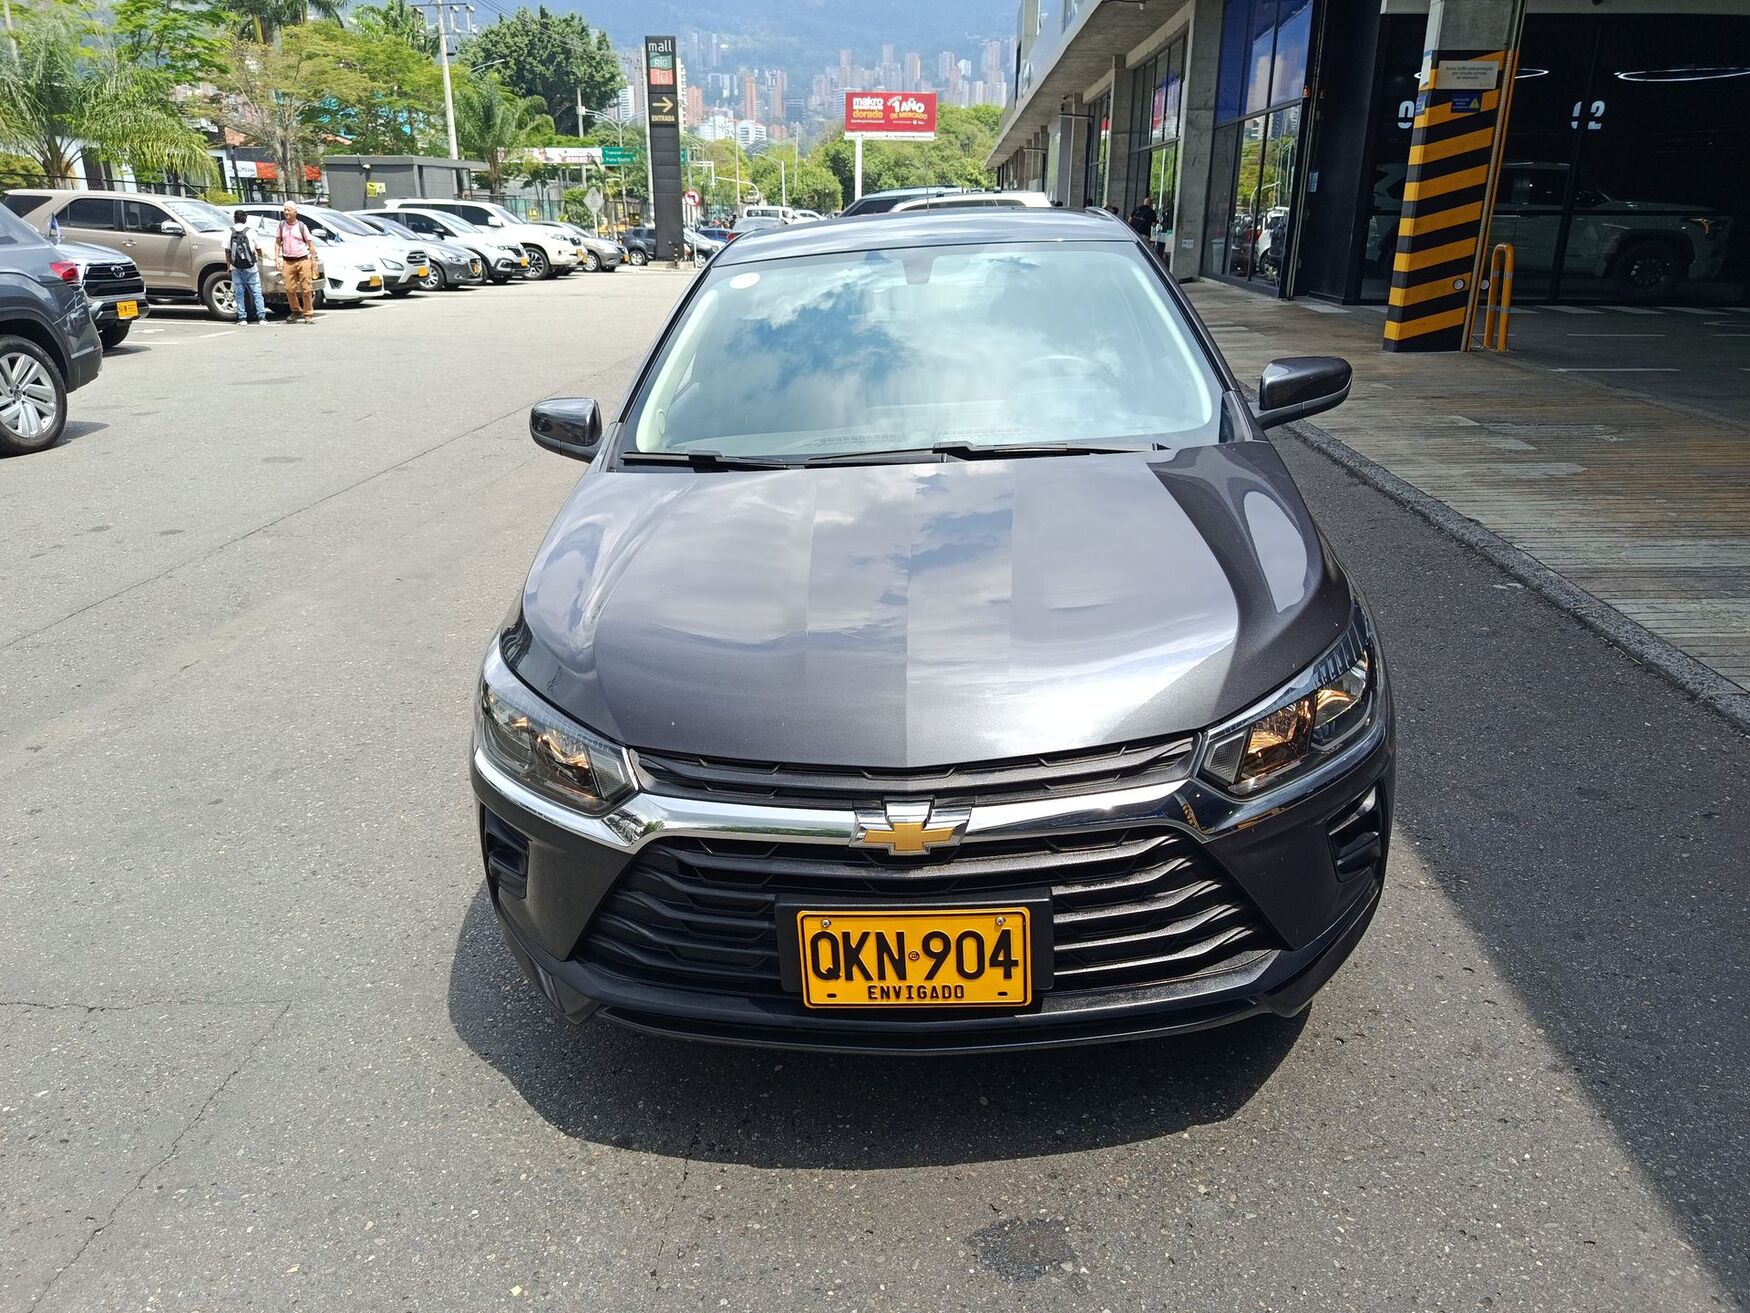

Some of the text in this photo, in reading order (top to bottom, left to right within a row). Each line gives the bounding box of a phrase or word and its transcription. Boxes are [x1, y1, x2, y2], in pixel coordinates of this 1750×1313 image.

[648, 39, 673, 52] mall
[655, 70, 669, 84] 10
[901, 98, 925, 113] AÑO
[852, 109, 884, 119] dorado
[898, 111, 928, 120] MERCADO
[810, 929, 1019, 981] QKN 904
[867, 984, 965, 999] ENVIGADO
